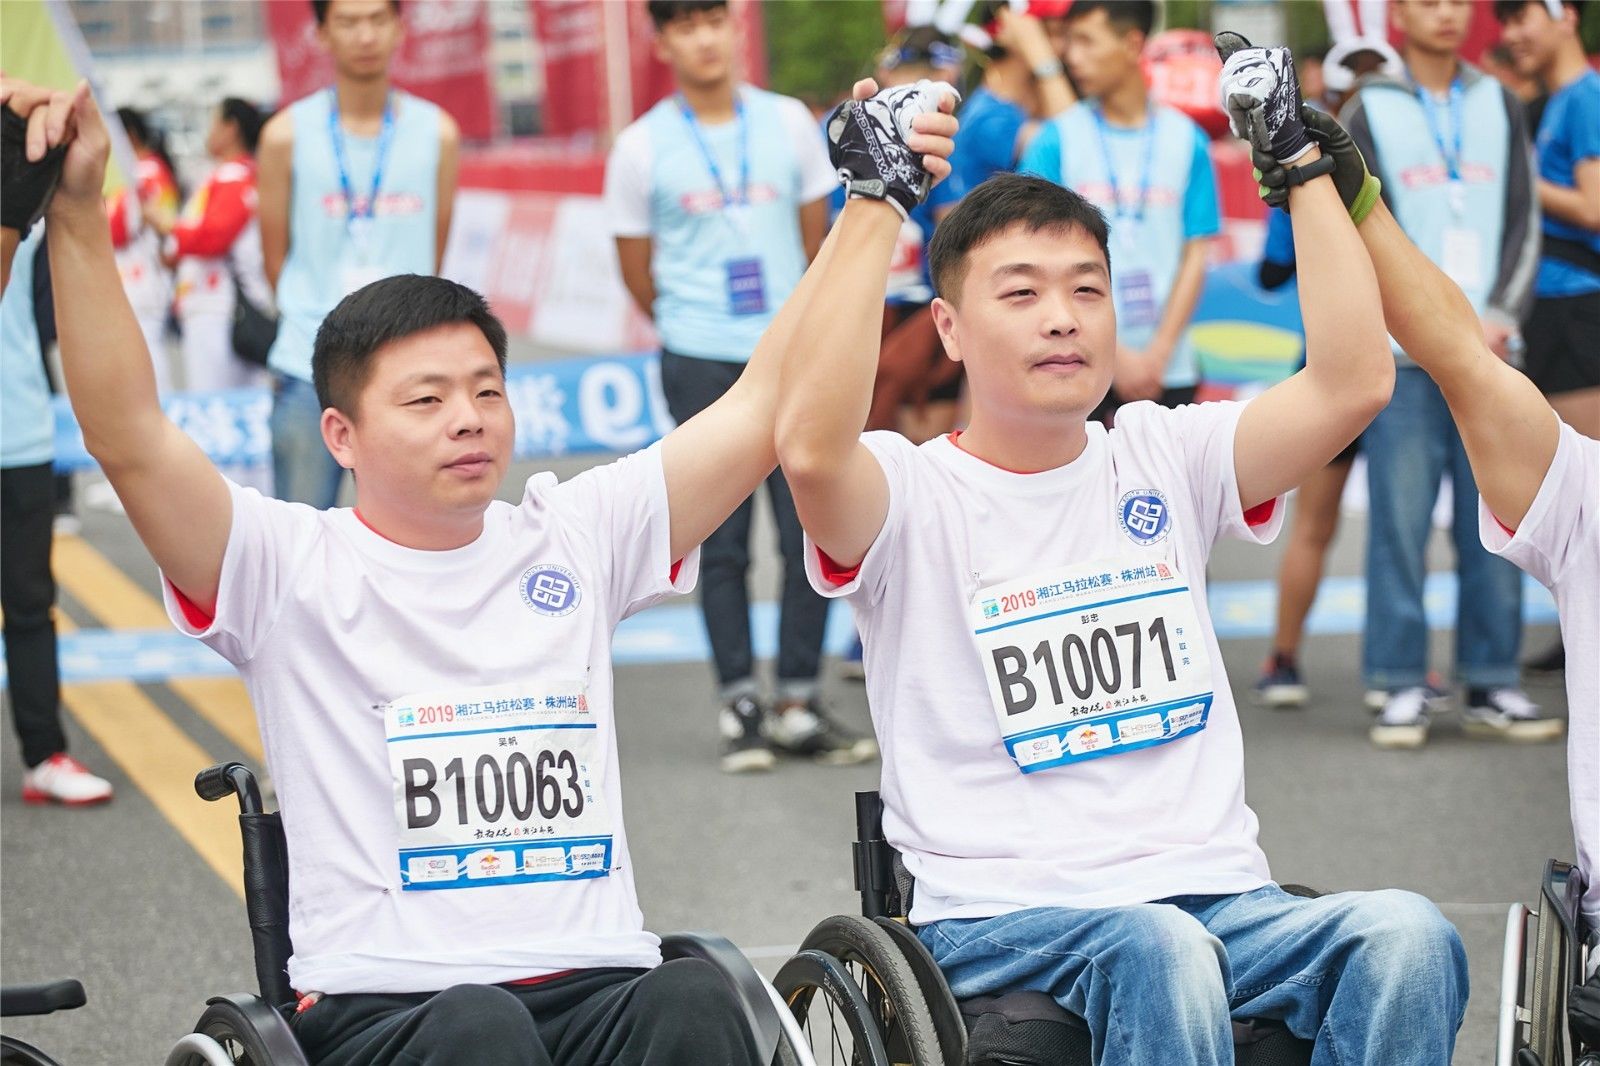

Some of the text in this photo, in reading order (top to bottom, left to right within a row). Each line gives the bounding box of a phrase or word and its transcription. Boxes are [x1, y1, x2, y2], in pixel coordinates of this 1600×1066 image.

[1001, 590, 1036, 613] 2019
[1080, 612, 1100, 625] 彭忠
[991, 616, 1177, 717] B10071
[418, 705, 454, 724] 2019
[402, 749, 585, 830] B10063
